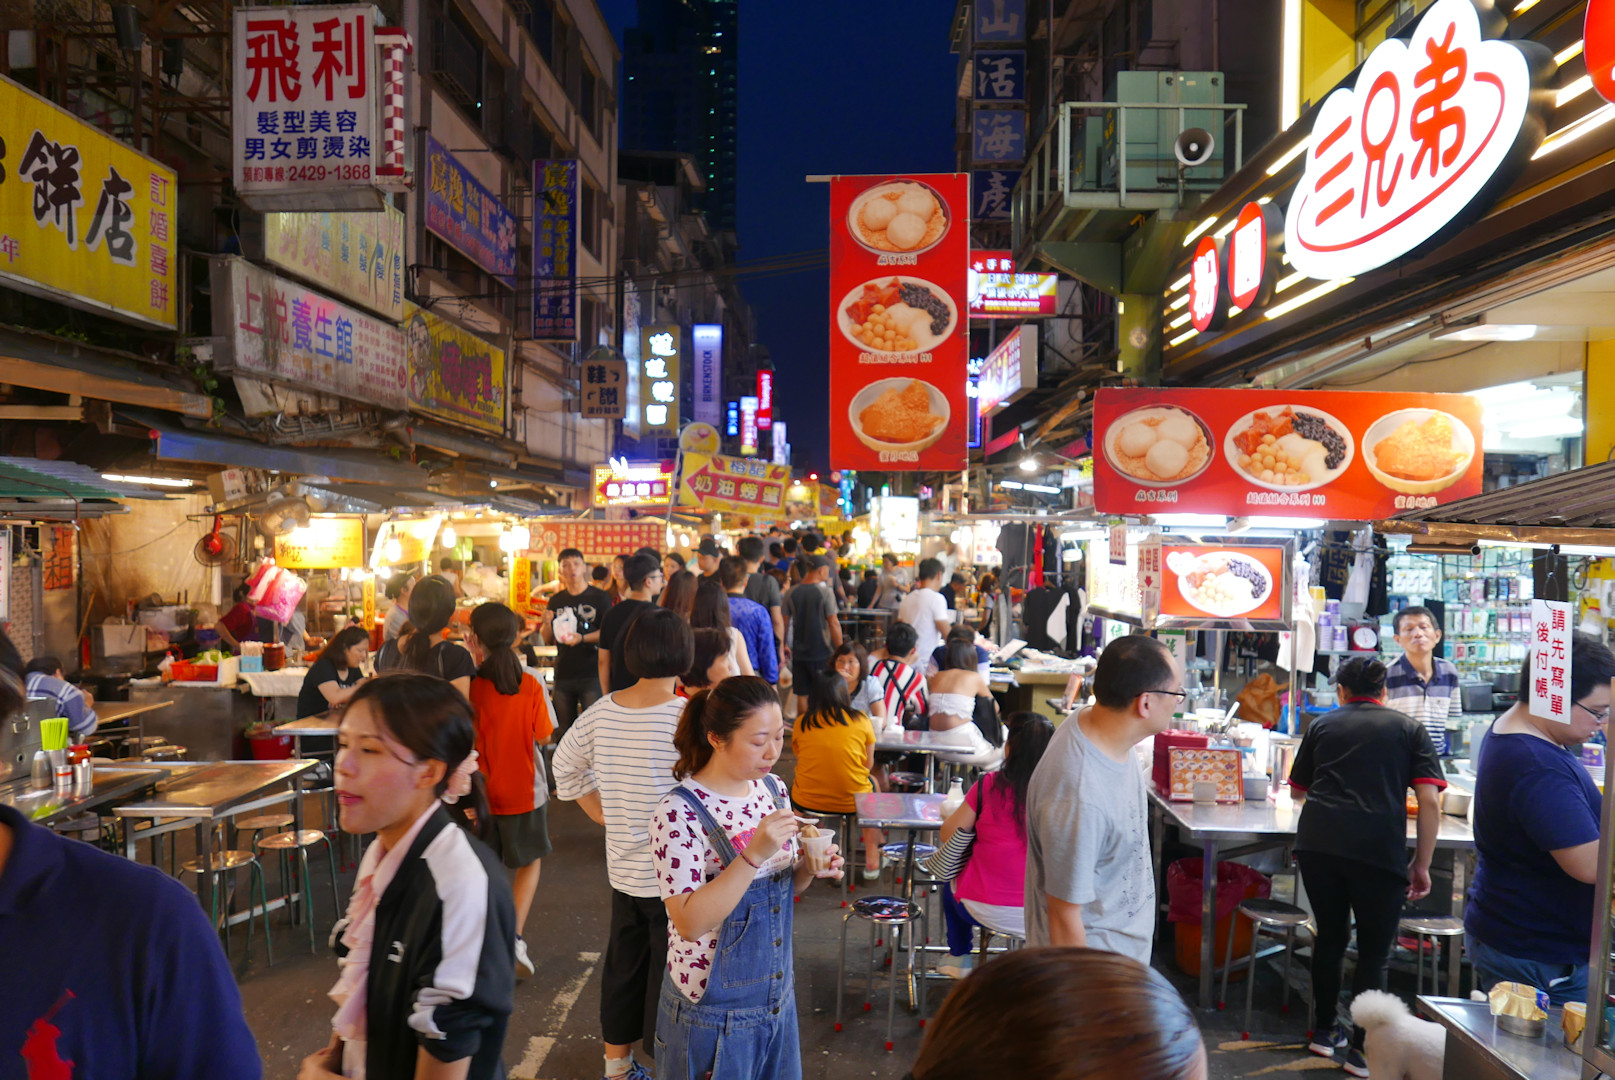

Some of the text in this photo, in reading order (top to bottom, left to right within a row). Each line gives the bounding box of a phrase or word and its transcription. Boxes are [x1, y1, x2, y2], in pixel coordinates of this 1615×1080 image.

[246, 15, 367, 103] 飛利
[257, 109, 357, 135] 髮型美容
[1314, 21, 1468, 228] 三兄弟
[244, 135, 371, 160] 男女剪燙染
[0, 129, 136, 267] 餅店
[1, 235, 19, 263] 年
[876, 254, 918, 266] 麻吉系列
[702, 350, 713, 402] BIRKENSTOCK
[694, 474, 780, 504] 奶油螃蟹
[1135, 490, 1178, 503] 麻吉系列
[1535, 621, 1549, 700] 後付帳
[1551, 609, 1566, 716] 請先寫單
